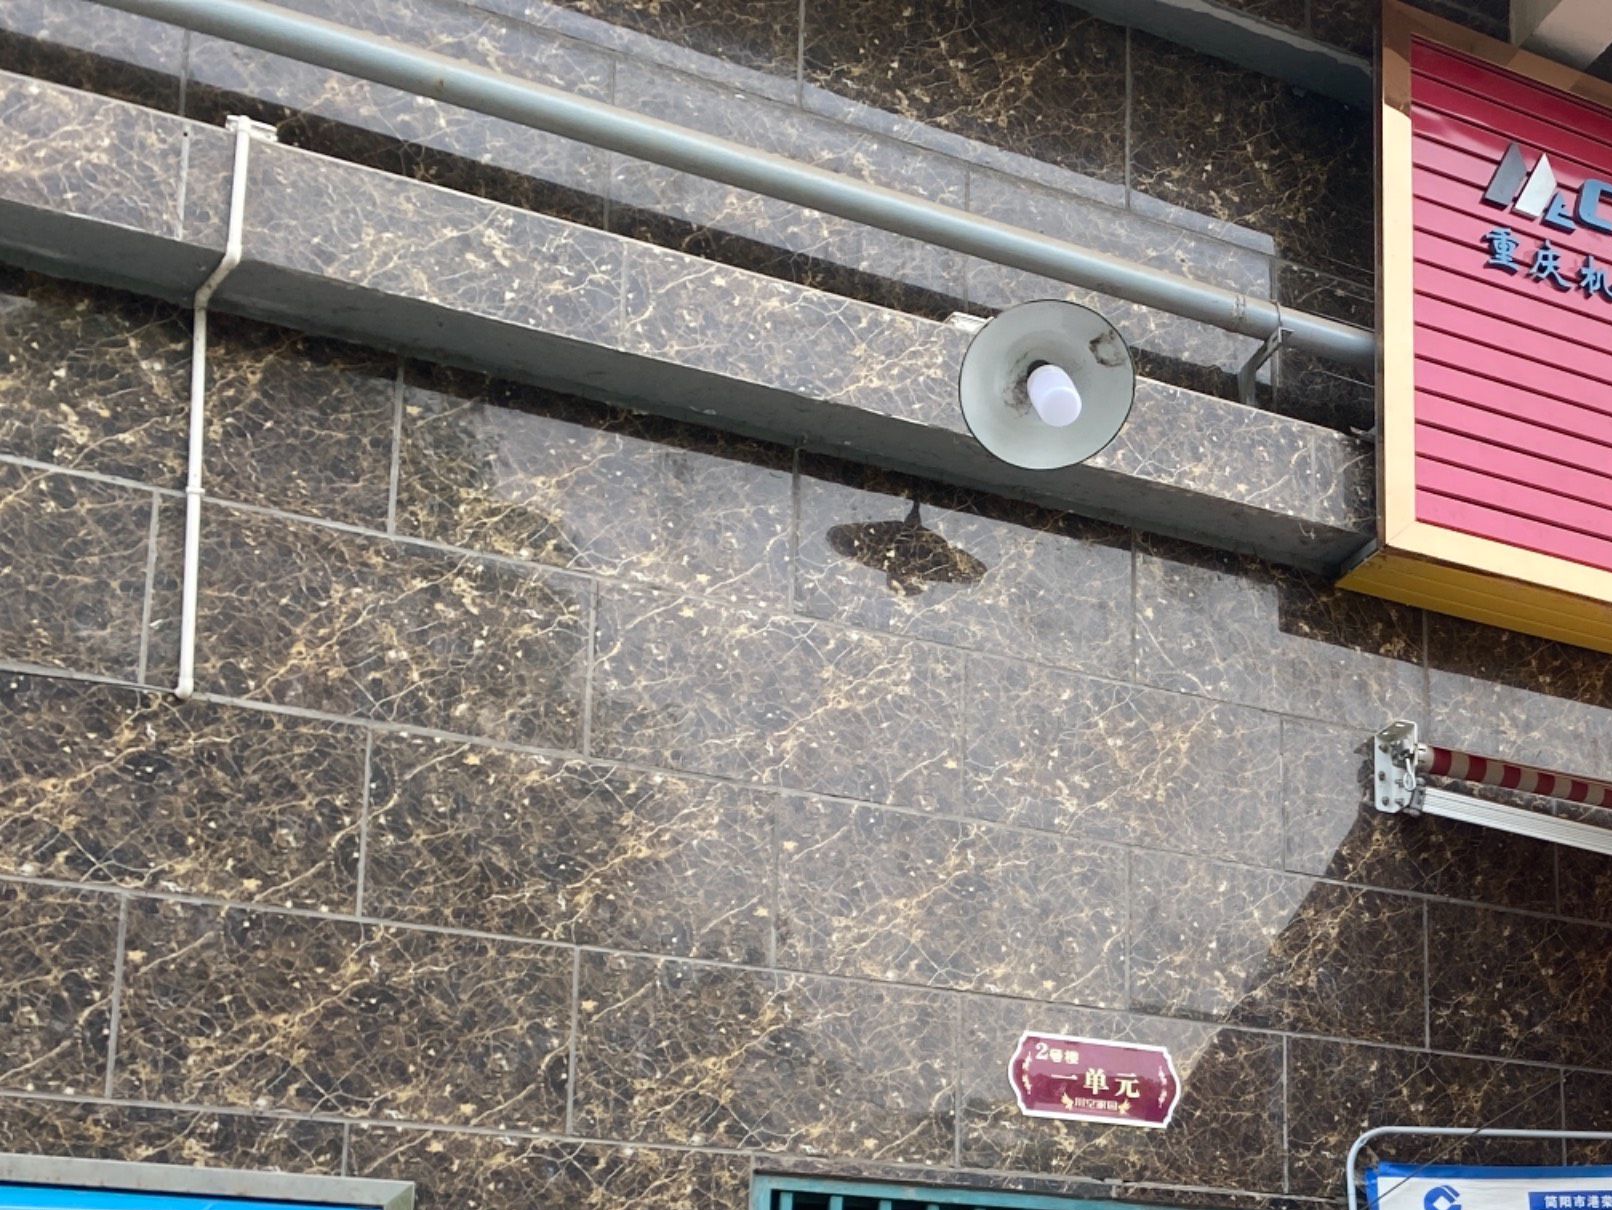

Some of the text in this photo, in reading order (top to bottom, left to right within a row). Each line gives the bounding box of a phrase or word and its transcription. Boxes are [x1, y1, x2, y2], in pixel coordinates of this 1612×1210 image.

[1035, 1042, 1080, 1065] 2号楼
[1050, 1067, 1141, 1098] 一单元
